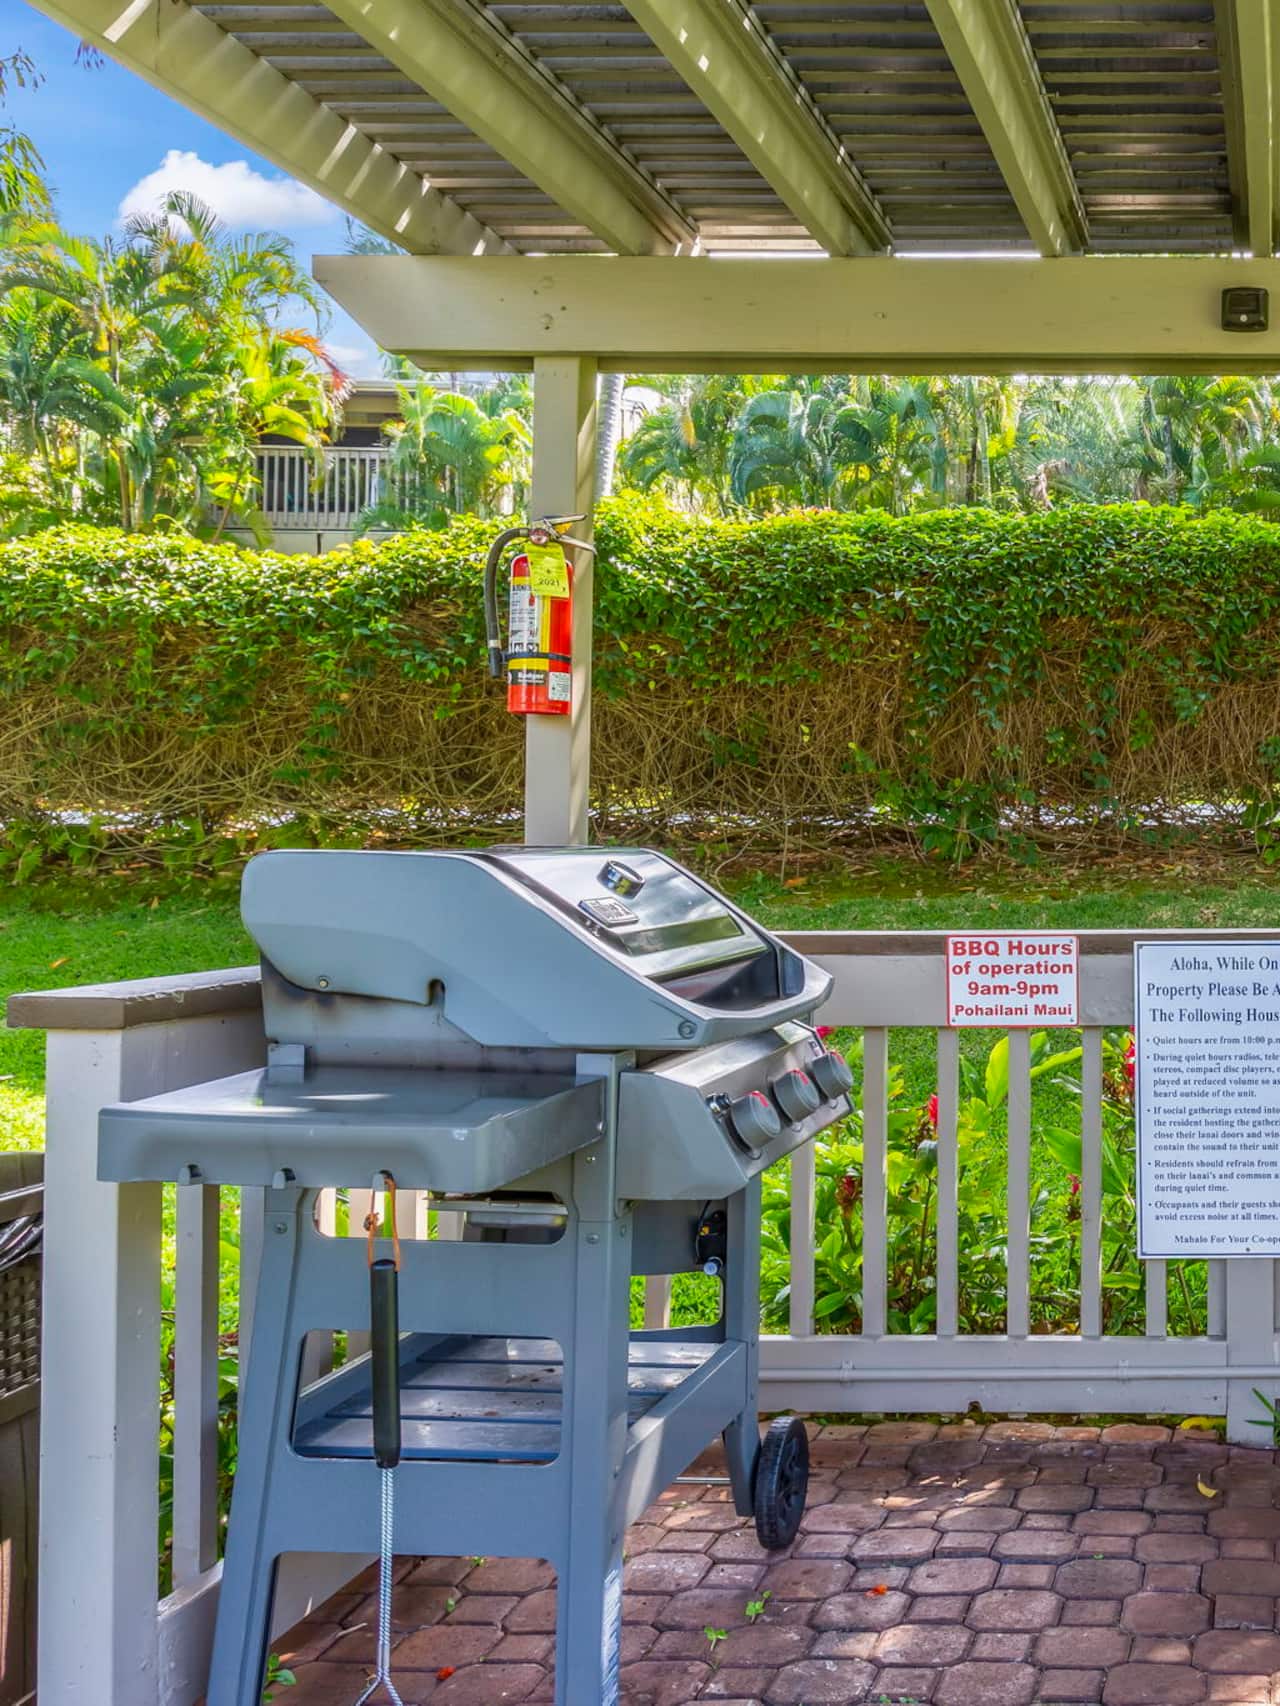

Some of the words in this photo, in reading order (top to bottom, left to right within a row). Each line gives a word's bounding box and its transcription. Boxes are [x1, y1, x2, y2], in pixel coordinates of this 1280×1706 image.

[538, 578, 560, 587] 2021
[952, 941, 1000, 956] BBQ
[1008, 941, 1072, 956] Hours
[1170, 957, 1213, 971] Aloha,
[1216, 957, 1255, 970] While
[1259, 957, 1278, 970] On
[952, 961, 971, 975] of
[978, 961, 1073, 977] operation
[968, 982, 1059, 998] 9am-9pm
[1147, 983, 1203, 999] Property
[1209, 983, 1248, 996] Please
[1253, 983, 1269, 996] Be
[955, 1005, 1028, 1016] Pohailani
[1034, 1004, 1072, 1015] Maui
[1150, 1008, 1174, 1022] The
[1179, 1008, 1242, 1024] Following
[1153, 1036, 1176, 1045] Quiet
[1179, 1036, 1202, 1044] hours
[1220, 1036, 1240, 1044] from
[1243, 1036, 1265, 1044] 10:00
[1153, 1054, 1182, 1062] During
[1185, 1054, 1206, 1062] quiet
[1208, 1053, 1232, 1061] hours
[1186, 1066, 1221, 1074] compact
[1224, 1065, 1239, 1073] disc
[1242, 1065, 1275, 1074] players,
[1153, 1090, 1177, 1098] heard
[1179, 1090, 1209, 1098] outside
[1212, 1090, 1221, 1098] of
[1222, 1090, 1235, 1098] the
[1237, 1090, 1256, 1098] unit.
[1188, 1107, 1232, 1116] gatherings
[1154, 1119, 1167, 1127] the
[1169, 1119, 1201, 1127] resident
[1204, 1119, 1234, 1128] hosting
[1154, 1131, 1173, 1139] close
[1176, 1131, 1195, 1139] their
[1198, 1131, 1219, 1139] lanai
[1221, 1131, 1244, 1139] doors
[1247, 1131, 1262, 1139] and
[1154, 1143, 1184, 1151] contain
[1187, 1143, 1200, 1151] the
[1203, 1143, 1227, 1151] sound
[1240, 1143, 1260, 1151] their
[1262, 1143, 1279, 1151] unit
[1155, 1160, 1194, 1168] Residents
[1196, 1160, 1223, 1168] should
[1226, 1160, 1254, 1168] refrain
[1257, 1160, 1277, 1168] from
[1155, 1184, 1182, 1193] during
[1185, 1184, 1206, 1193] quiet
[1208, 1184, 1229, 1192] time.
[1155, 1201, 1198, 1210] Occupants
[1201, 1201, 1216, 1209] and
[1219, 1201, 1239, 1209] their
[1241, 1201, 1266, 1210] guests
[1155, 1213, 1177, 1221] avoid
[1208, 1213, 1228, 1221] noise
[1231, 1213, 1239, 1221] at
[1174, 1235, 1208, 1243] Mahalo
[1211, 1235, 1226, 1243] For
[1228, 1235, 1249, 1243] Your
